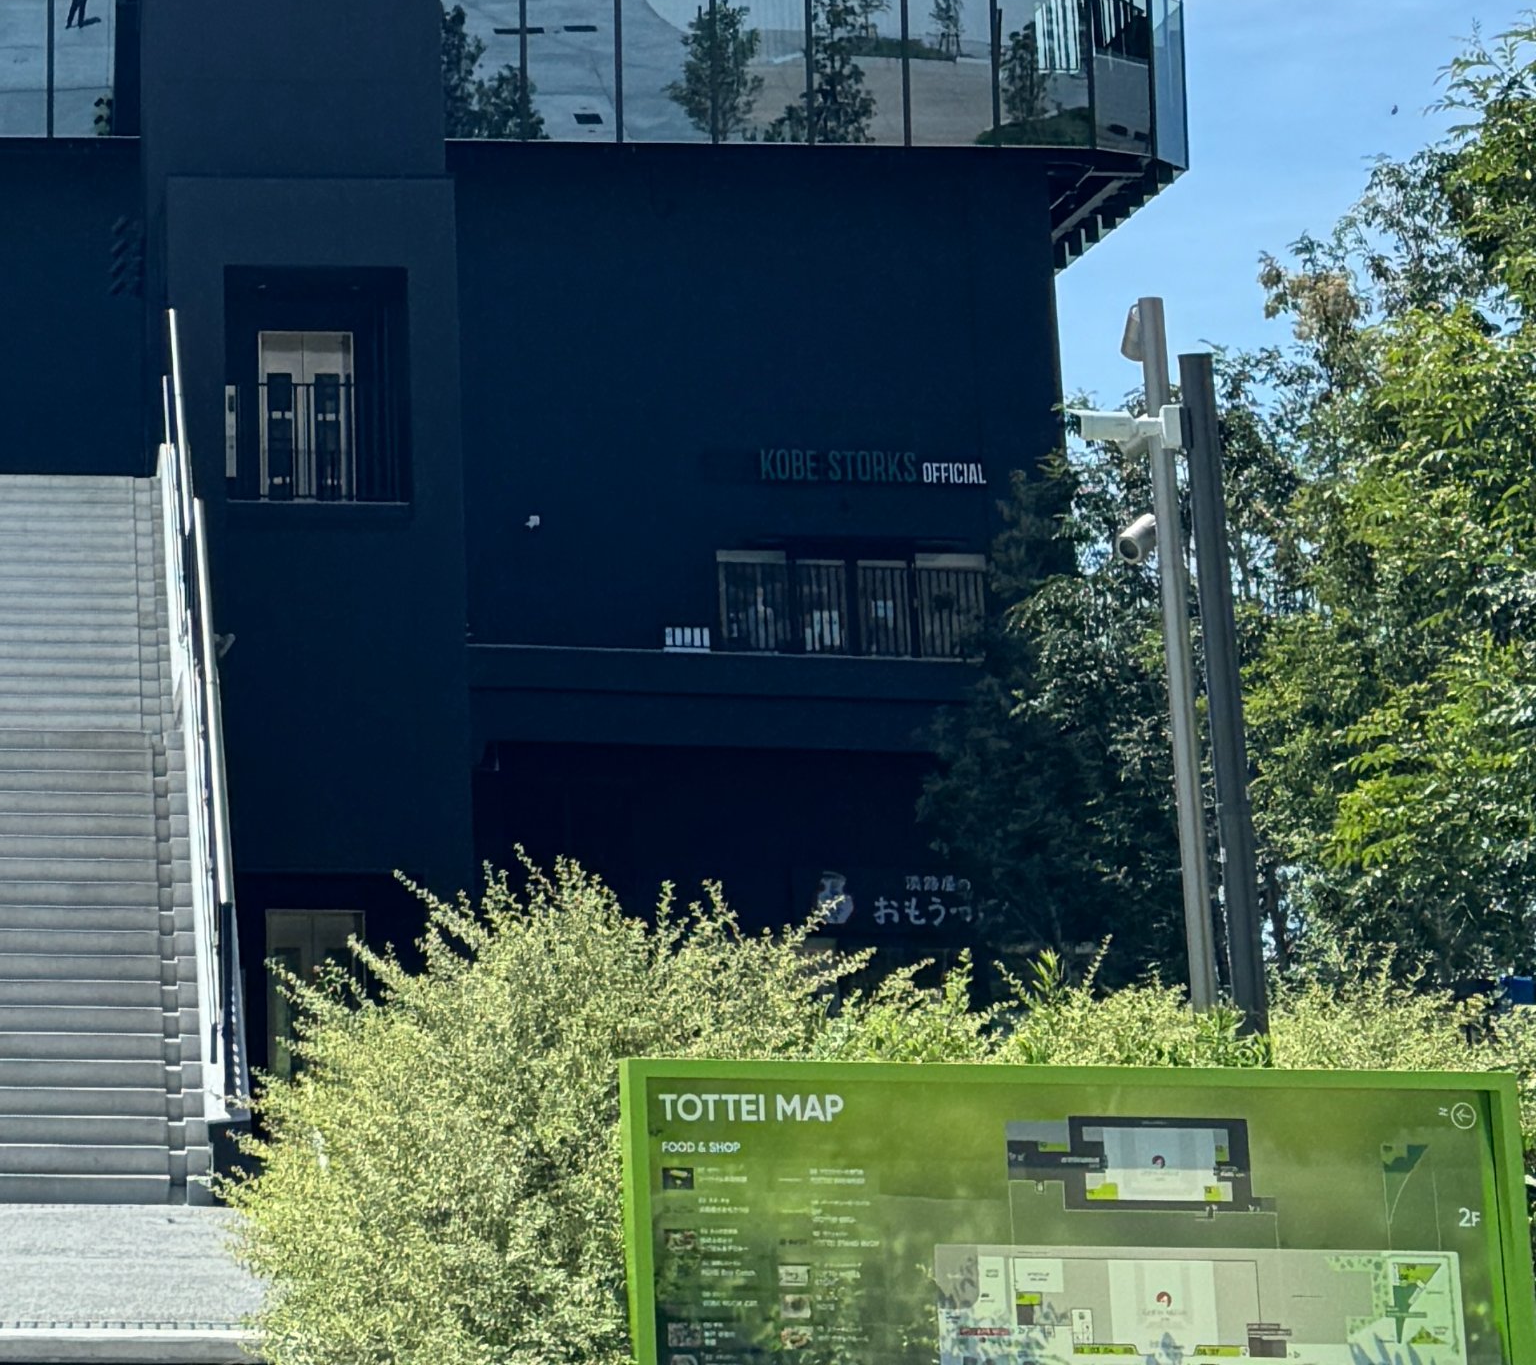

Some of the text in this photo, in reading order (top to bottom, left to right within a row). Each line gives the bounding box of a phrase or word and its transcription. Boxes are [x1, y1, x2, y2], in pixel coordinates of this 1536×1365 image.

[760, 449, 987, 484] KOBE STORKS OFFICIAL
[658, 1093, 844, 1122] TOTTEI MAP
[661, 1141, 741, 1153] FOOD & SHOP
[1458, 1207, 1481, 1227] 2F
